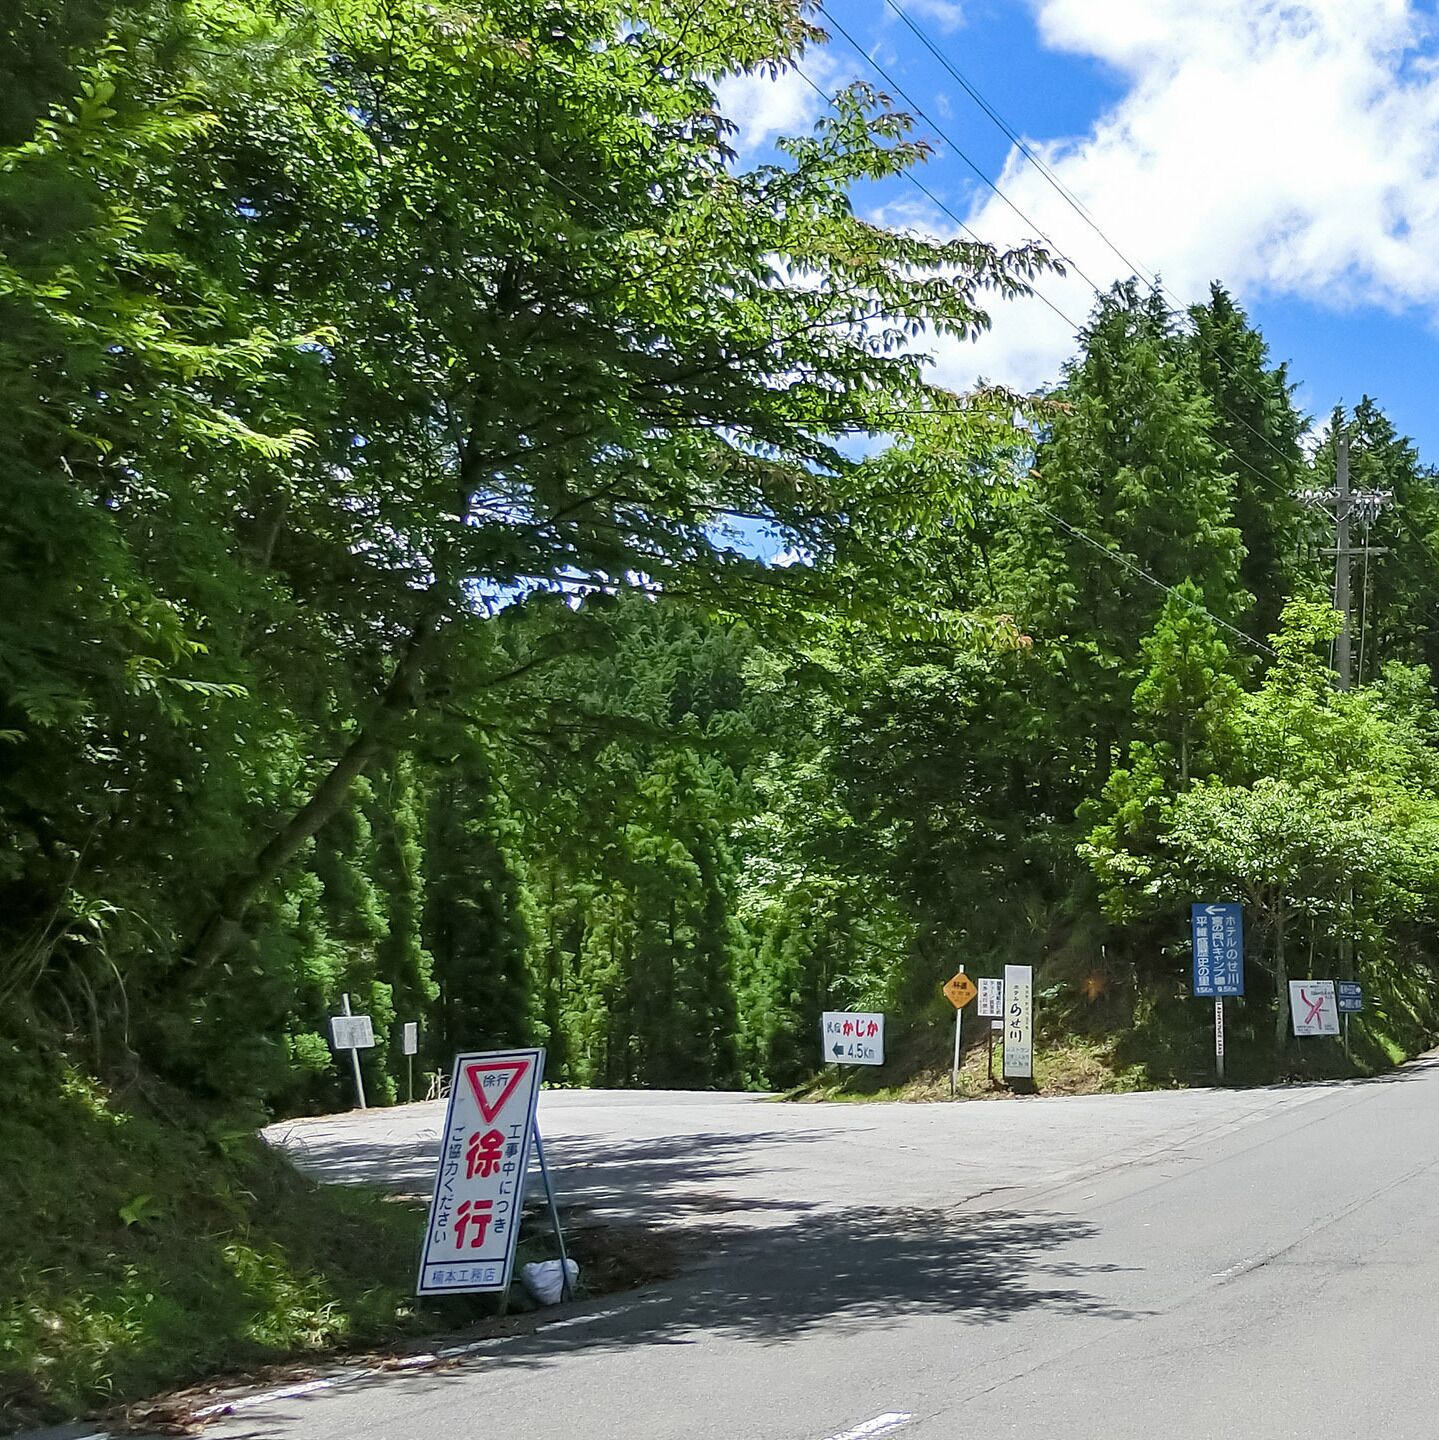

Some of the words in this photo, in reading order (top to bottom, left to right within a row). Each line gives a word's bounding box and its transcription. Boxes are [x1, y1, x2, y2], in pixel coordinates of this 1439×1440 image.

[842, 1019, 879, 1038] かじか
[1009, 1003, 1022, 1043] のせ川
[482, 1072, 510, 1089] 徐行
[433, 1125, 467, 1244] ご協力ください
[454, 1128, 506, 1250] 徐行
[493, 1123, 523, 1234] 工事中につき
